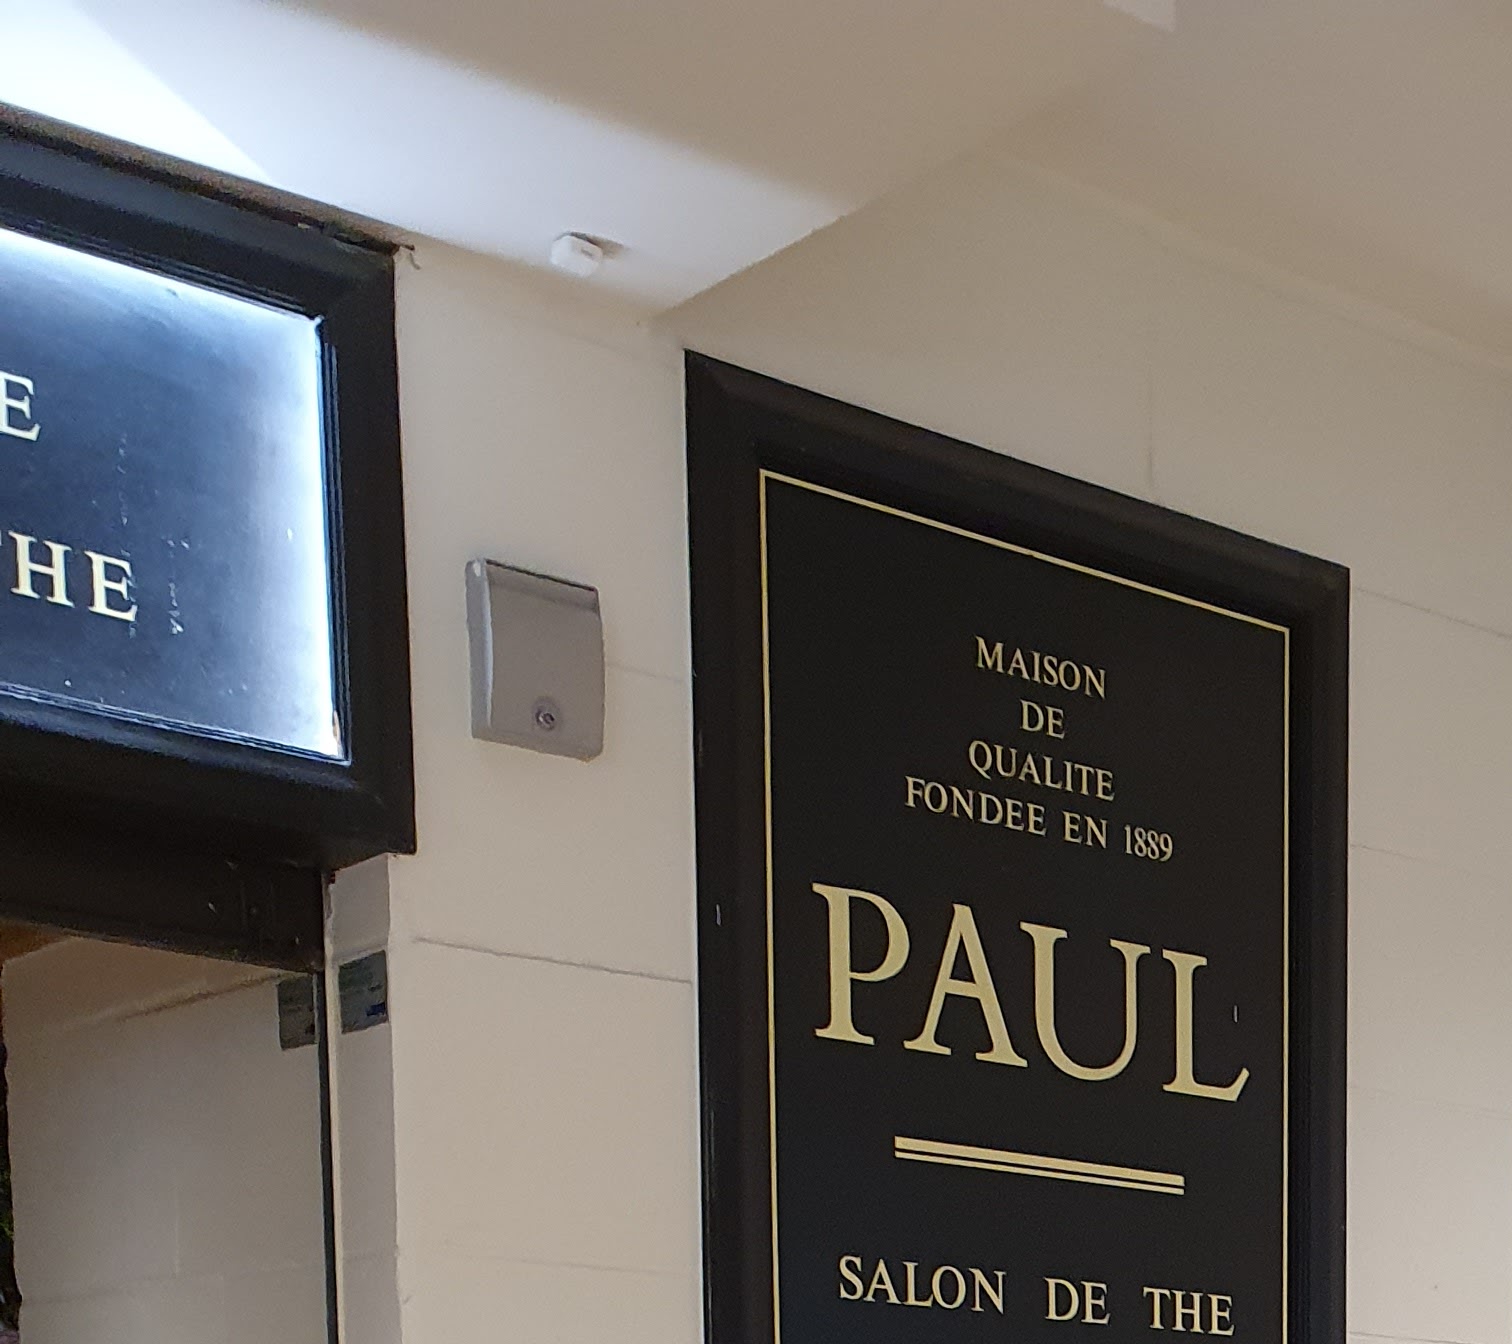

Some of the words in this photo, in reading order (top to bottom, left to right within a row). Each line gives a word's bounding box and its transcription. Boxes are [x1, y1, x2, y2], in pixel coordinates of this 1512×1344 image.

[0, 530, 138, 622] HE
[976, 636, 1105, 698] MAISON
[1020, 699, 1065, 739] DE
[968, 740, 1114, 801] QUALITE
[905, 776, 1046, 836] FONDEE
[1062, 811, 1107, 849] EN
[1124, 824, 1174, 862] 1889
[812, 882, 1250, 1102] PAUL
[839, 1255, 1007, 1314] SALON
[1044, 1277, 1110, 1325] DE
[1143, 1286, 1235, 1336] THE
